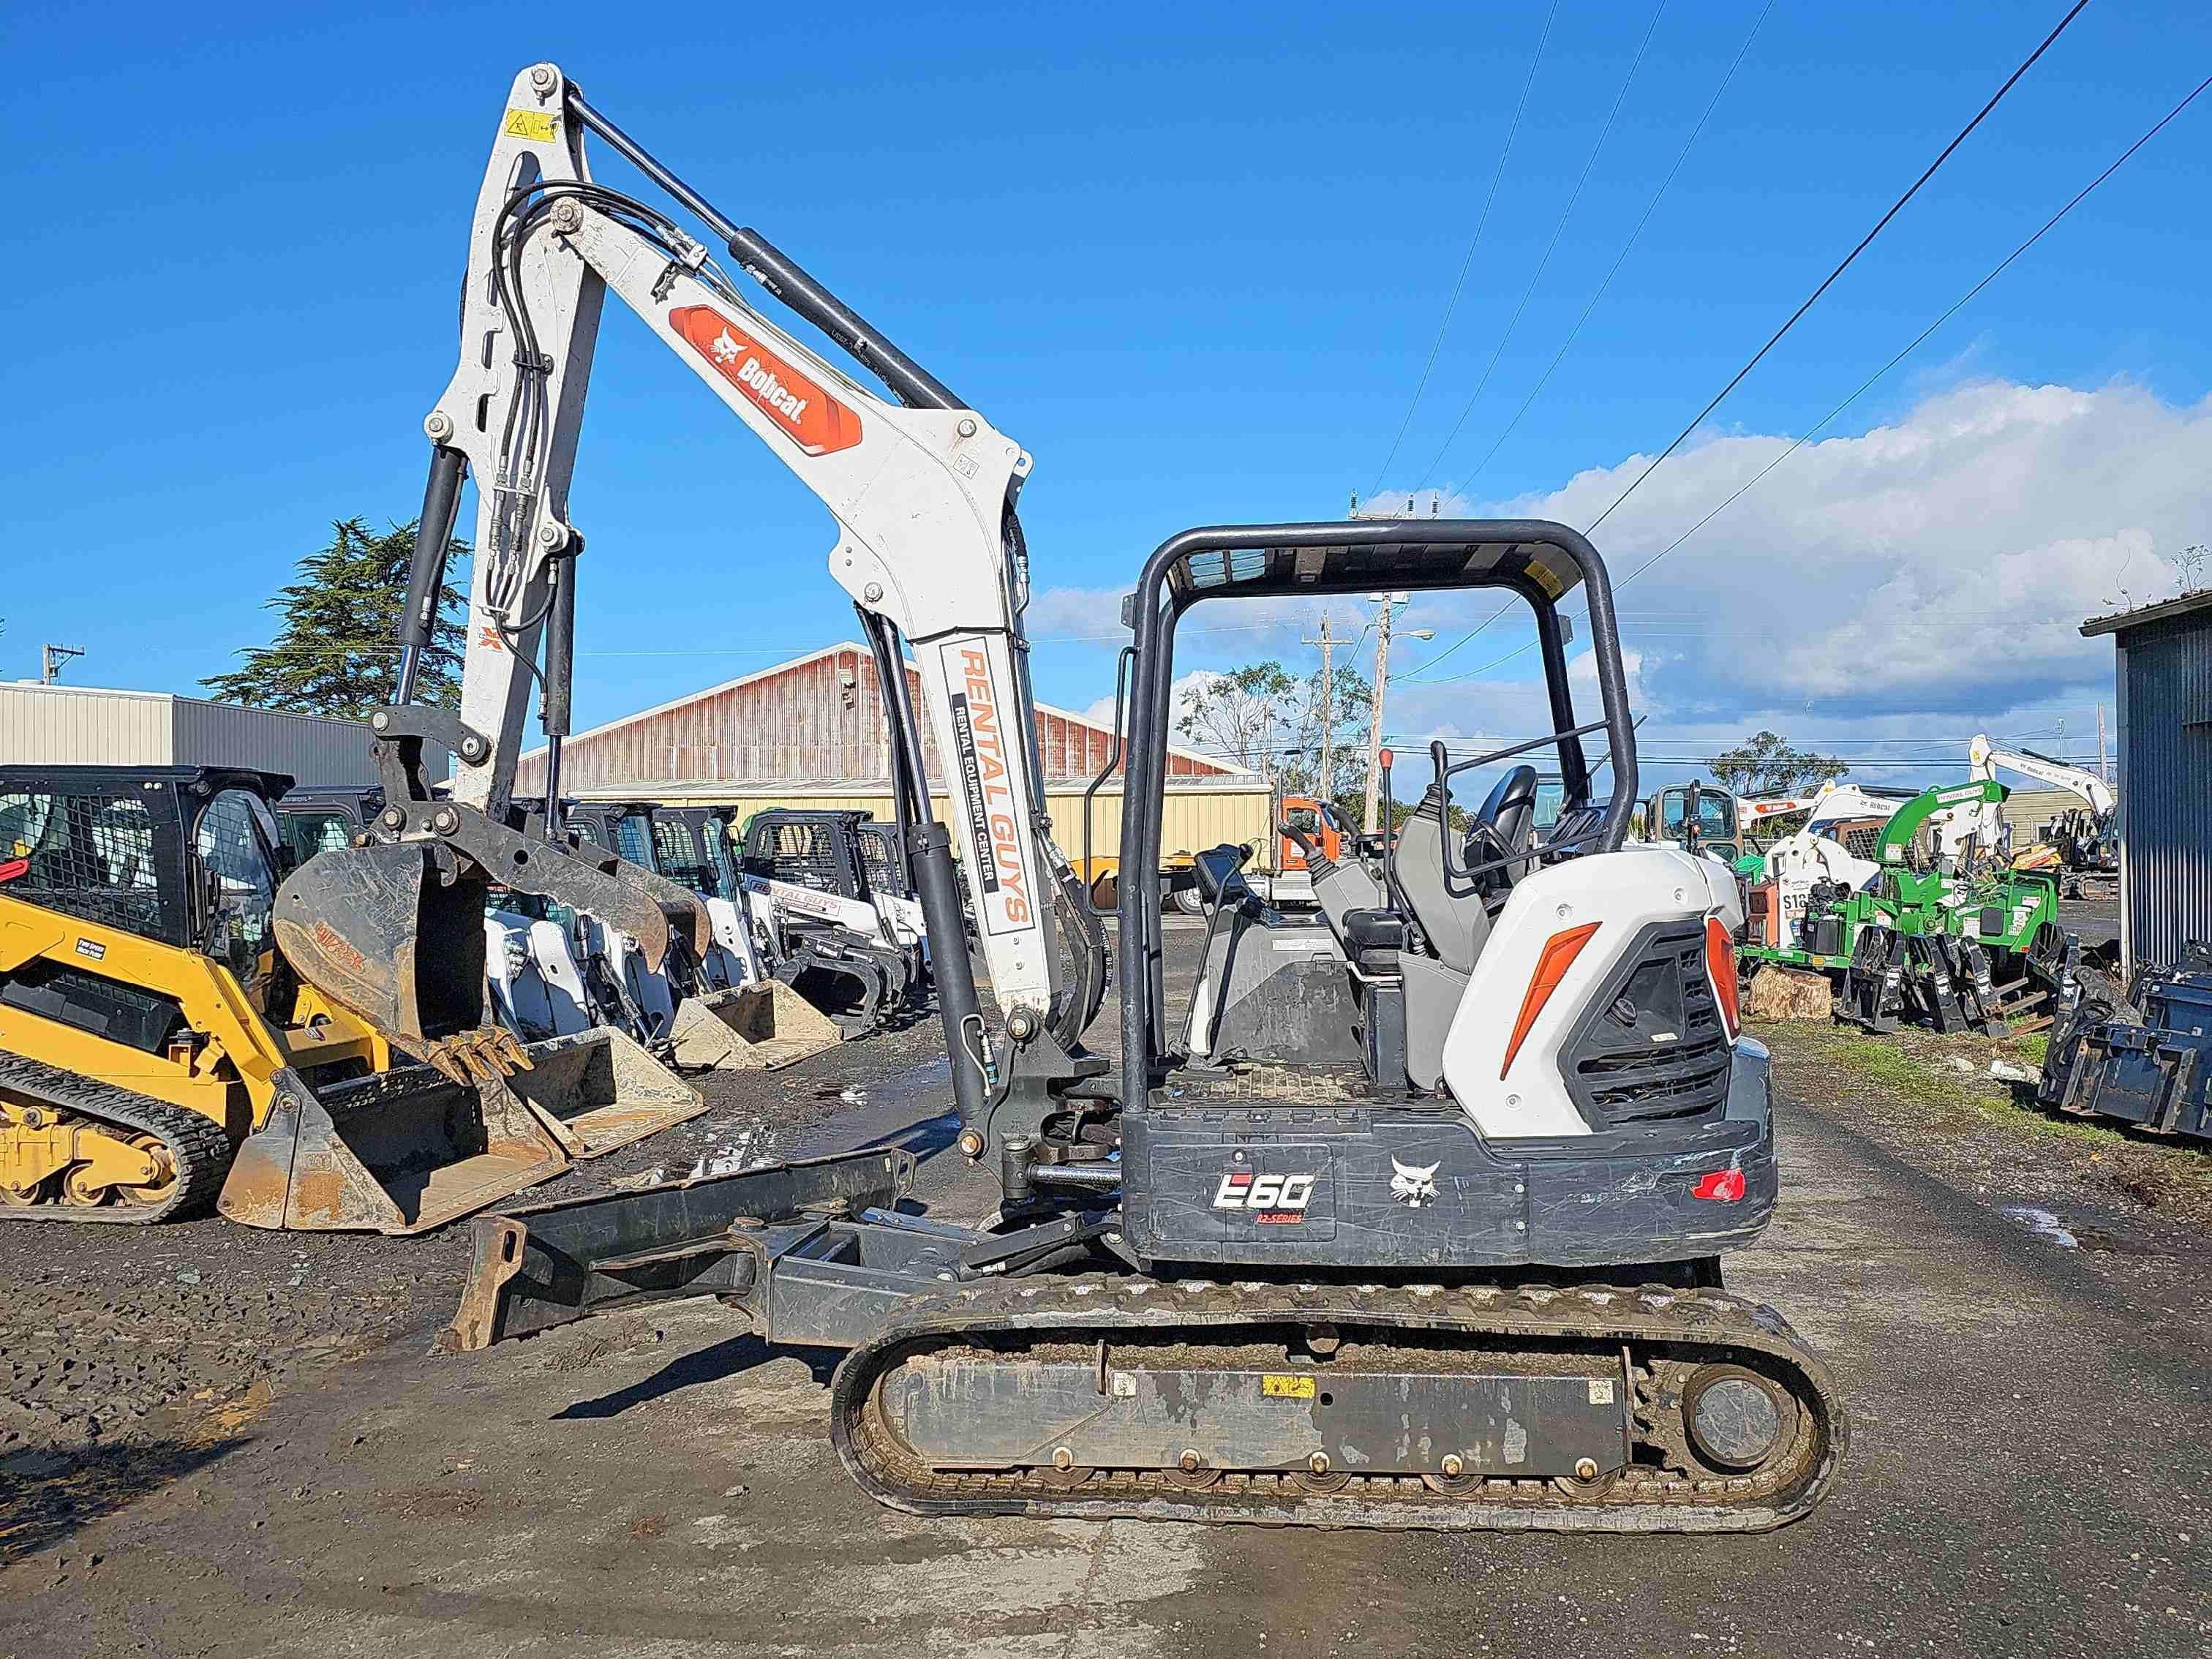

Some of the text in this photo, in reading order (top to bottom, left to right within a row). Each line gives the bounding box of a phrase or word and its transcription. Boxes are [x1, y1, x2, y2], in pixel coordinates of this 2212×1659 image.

[737, 357, 806, 424] Bobcat
[955, 707, 995, 881] RENTAL EQUIPMENT CENTER
[960, 649, 1028, 923] RENTAL GUYS
[804, 895, 838, 909] GUYS
[1211, 1173, 1316, 1209] E60
